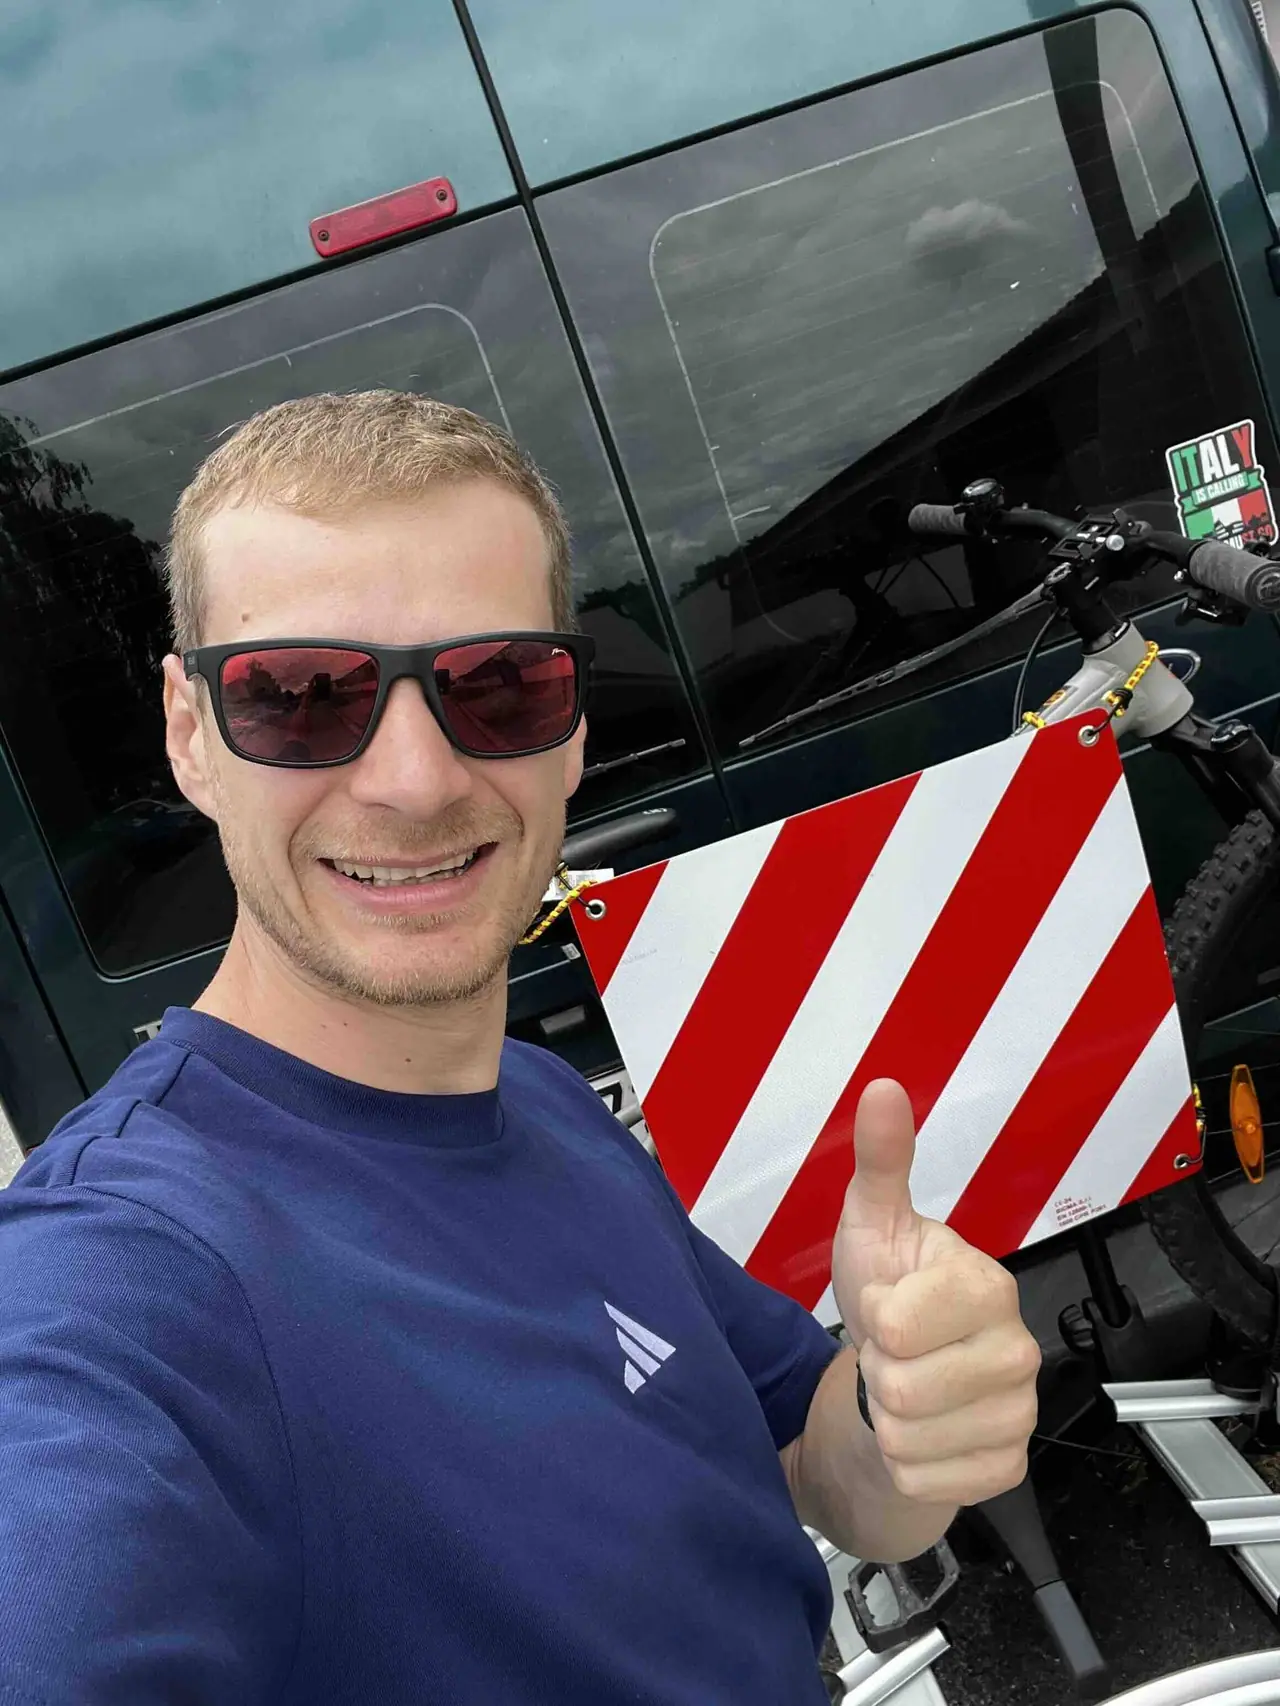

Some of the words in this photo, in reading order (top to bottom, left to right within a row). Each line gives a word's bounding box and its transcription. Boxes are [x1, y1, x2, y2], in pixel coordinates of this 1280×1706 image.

[1172, 425, 1252, 492] ITALY
[1195, 490, 1207, 503] IS
[1207, 476, 1246, 497] CALLING
